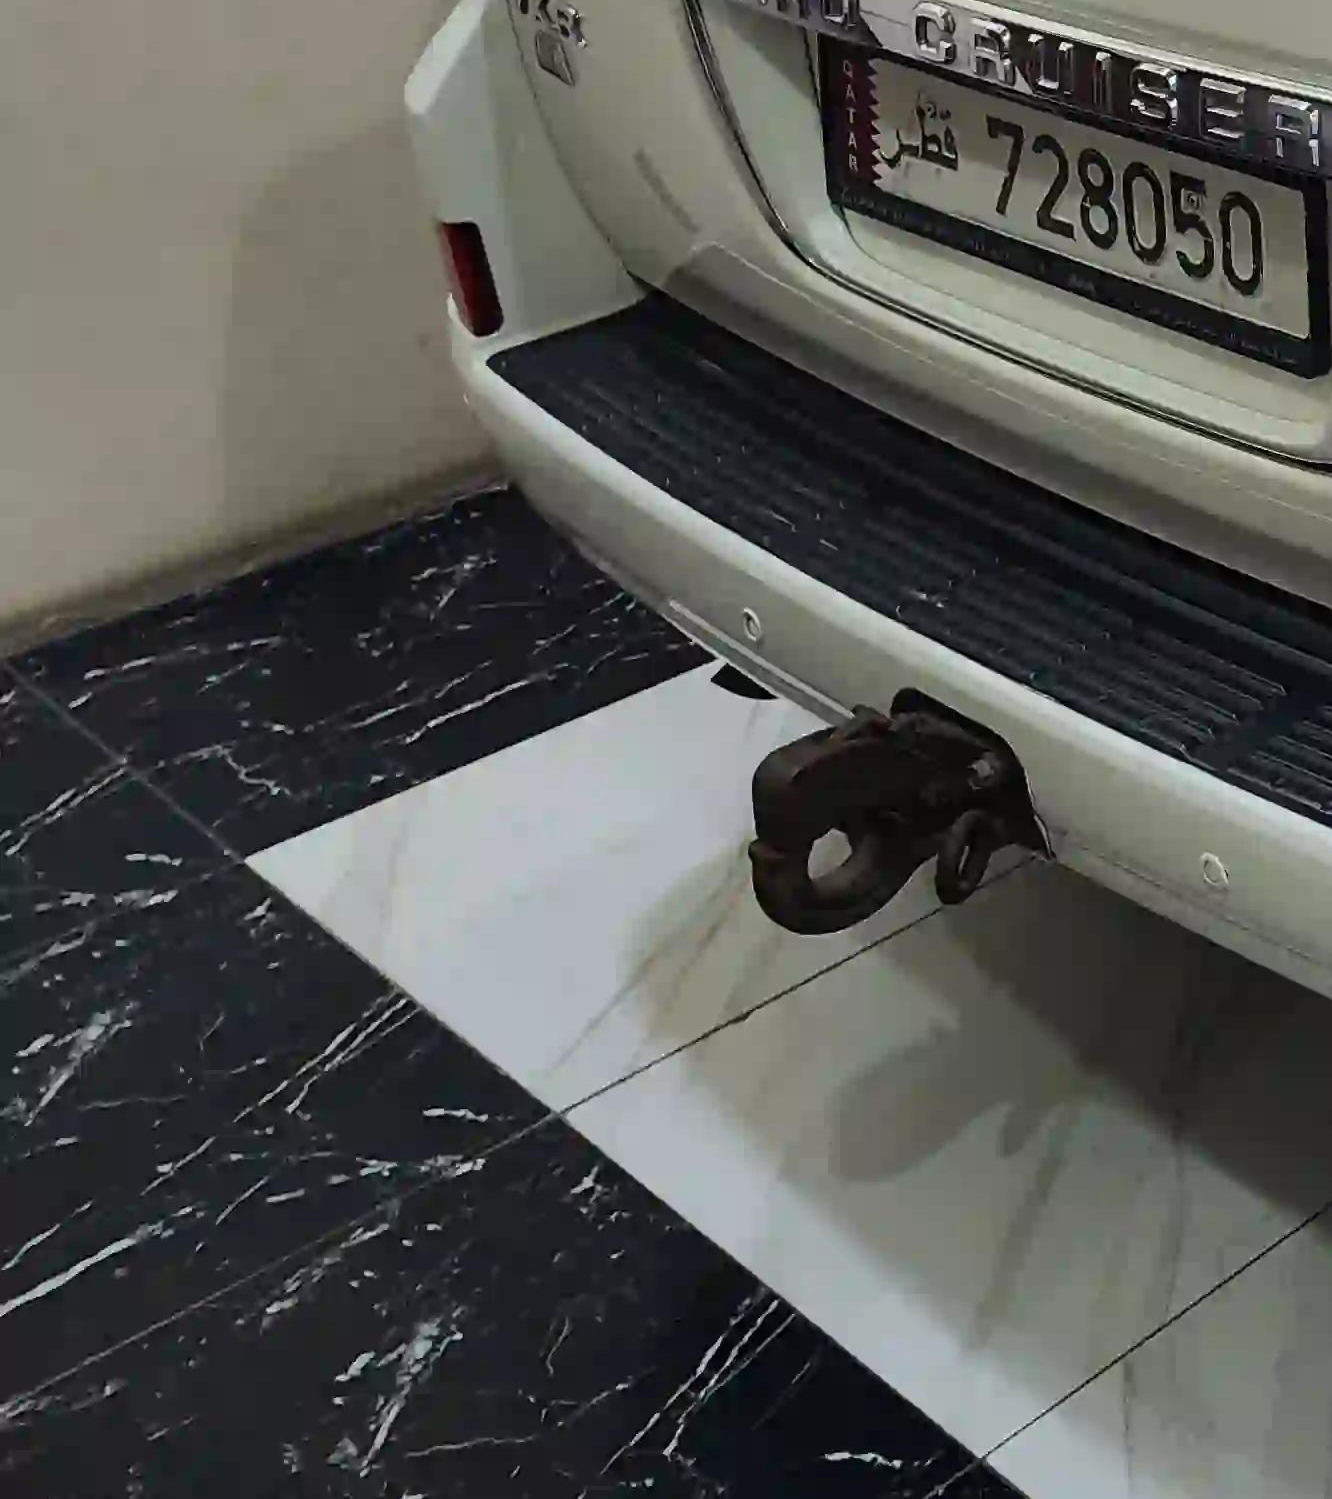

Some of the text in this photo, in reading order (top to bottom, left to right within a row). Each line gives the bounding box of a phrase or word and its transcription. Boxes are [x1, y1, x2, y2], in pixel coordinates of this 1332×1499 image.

[843, 59, 859, 174] QATAR
[879, 90, 959, 171] قطر
[914, 1, 1322, 168] CRUISER
[983, 112, 1265, 297] 728050
